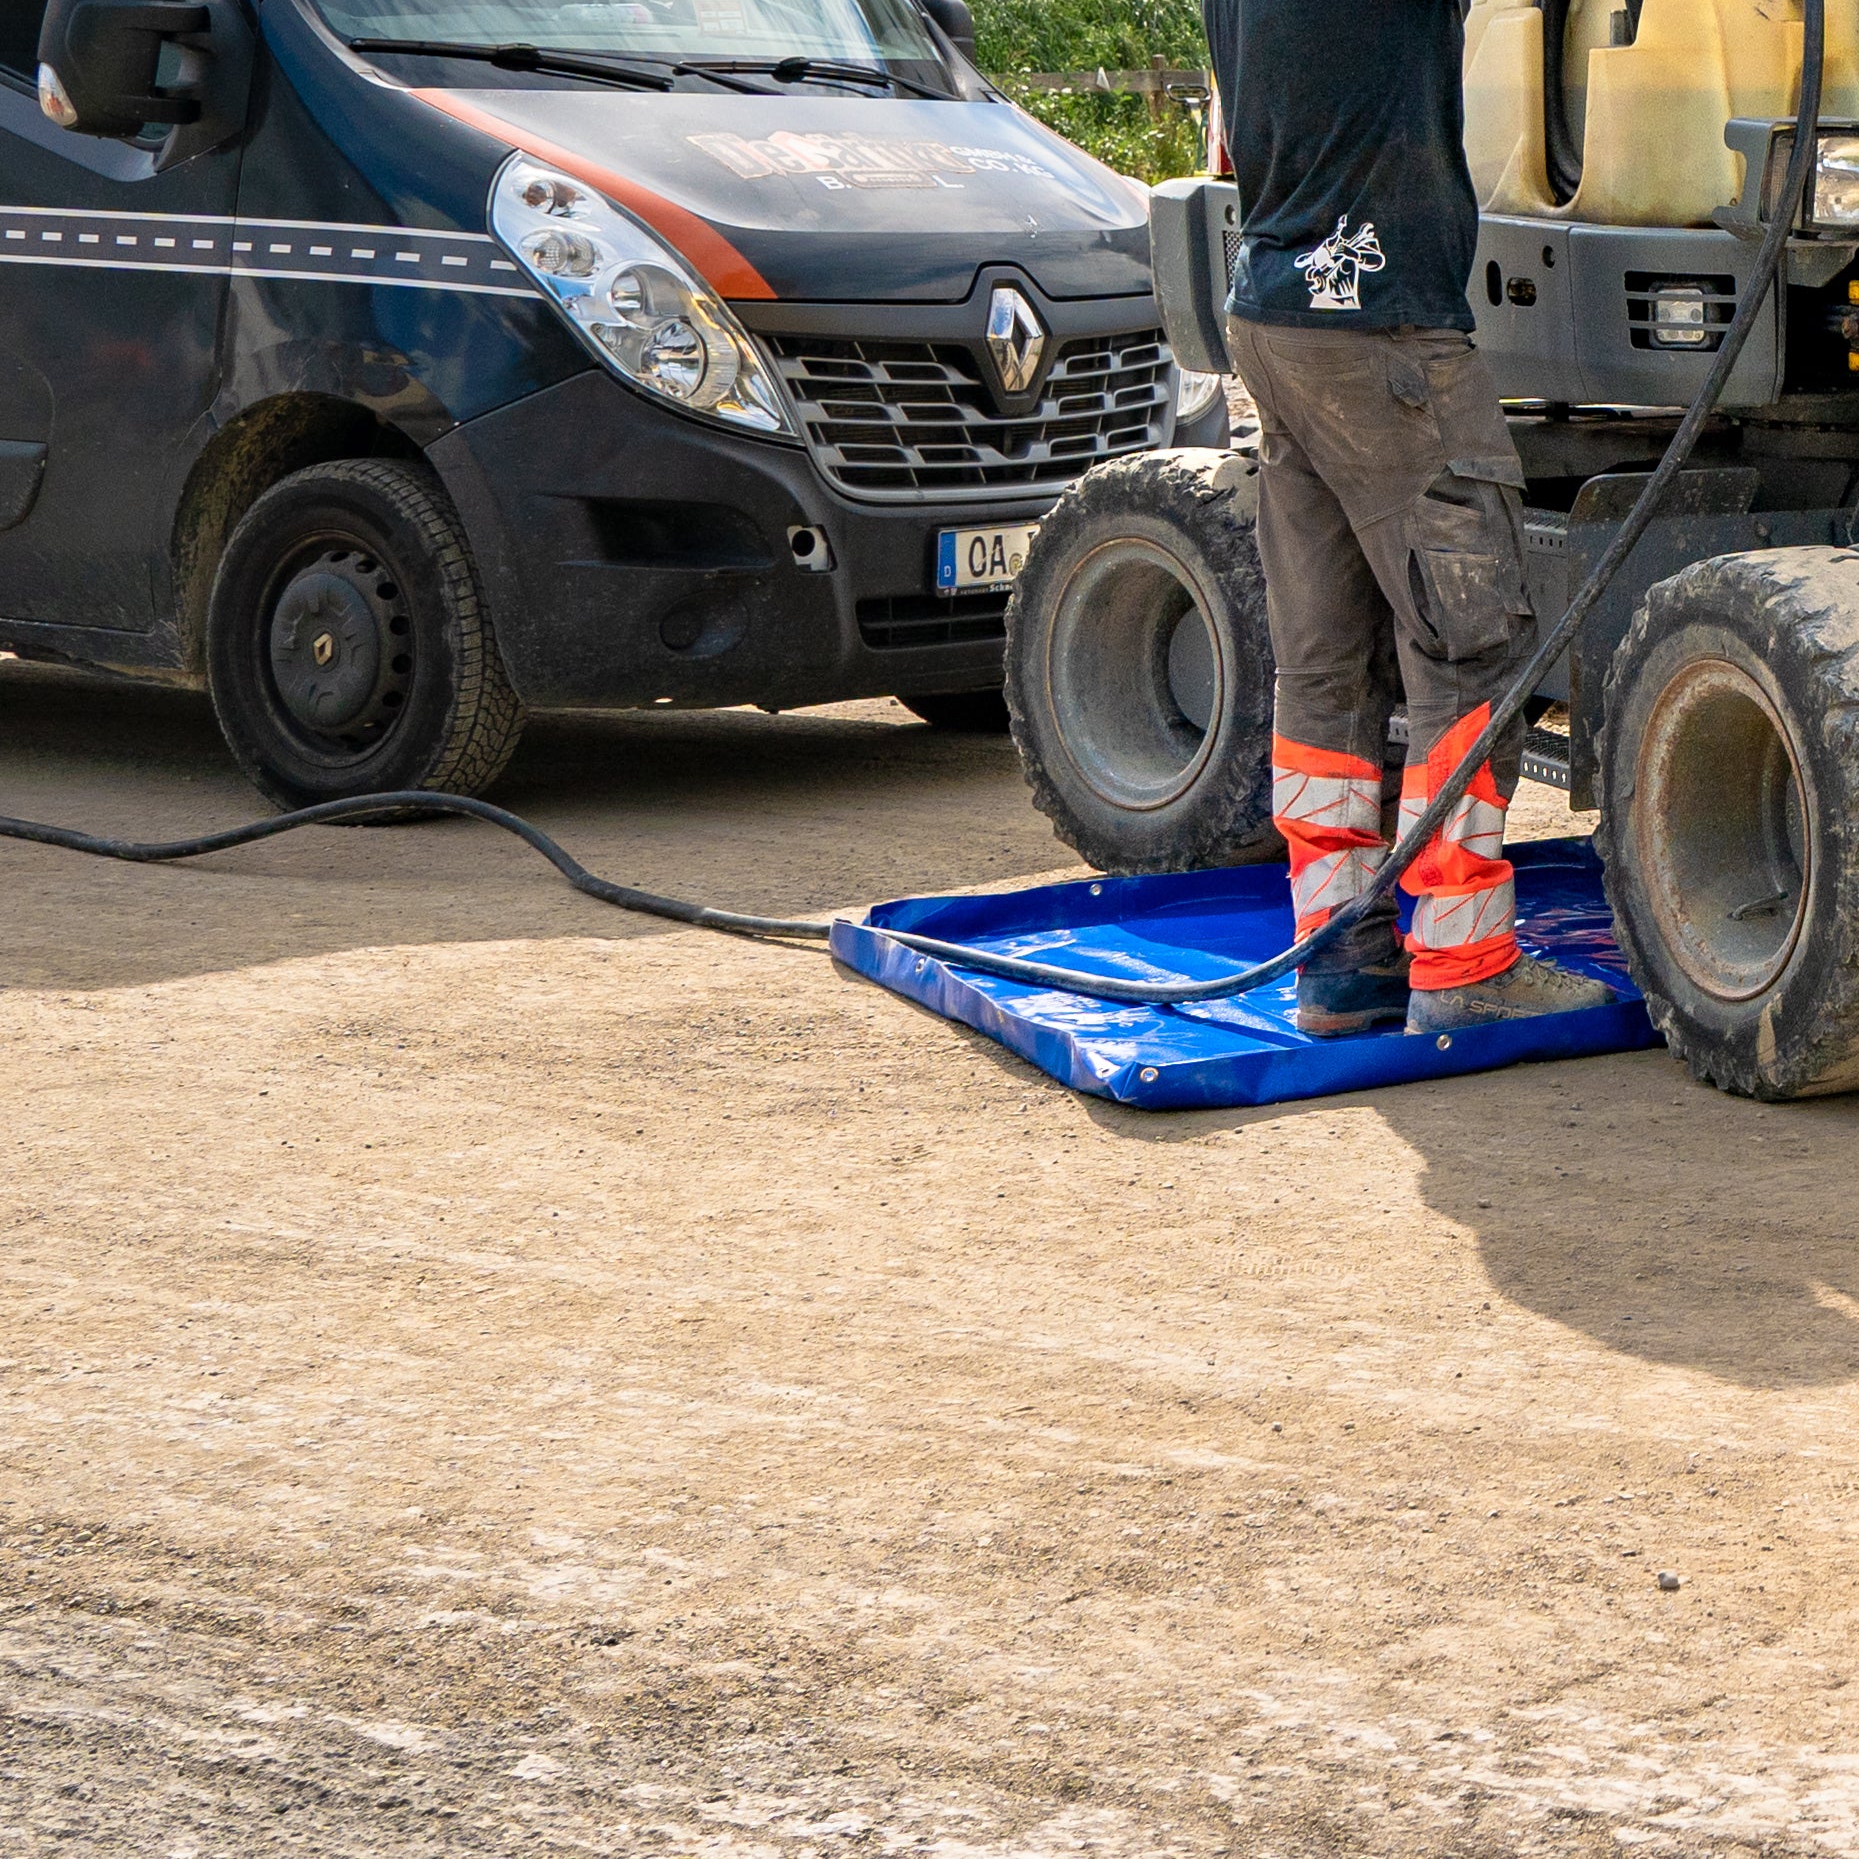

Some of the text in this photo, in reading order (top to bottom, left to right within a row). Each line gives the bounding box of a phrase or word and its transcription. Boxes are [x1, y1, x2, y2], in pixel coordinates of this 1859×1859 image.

[816, 175, 964, 190] B. L.
[944, 565, 952, 577] D
[968, 534, 1007, 578] OA
